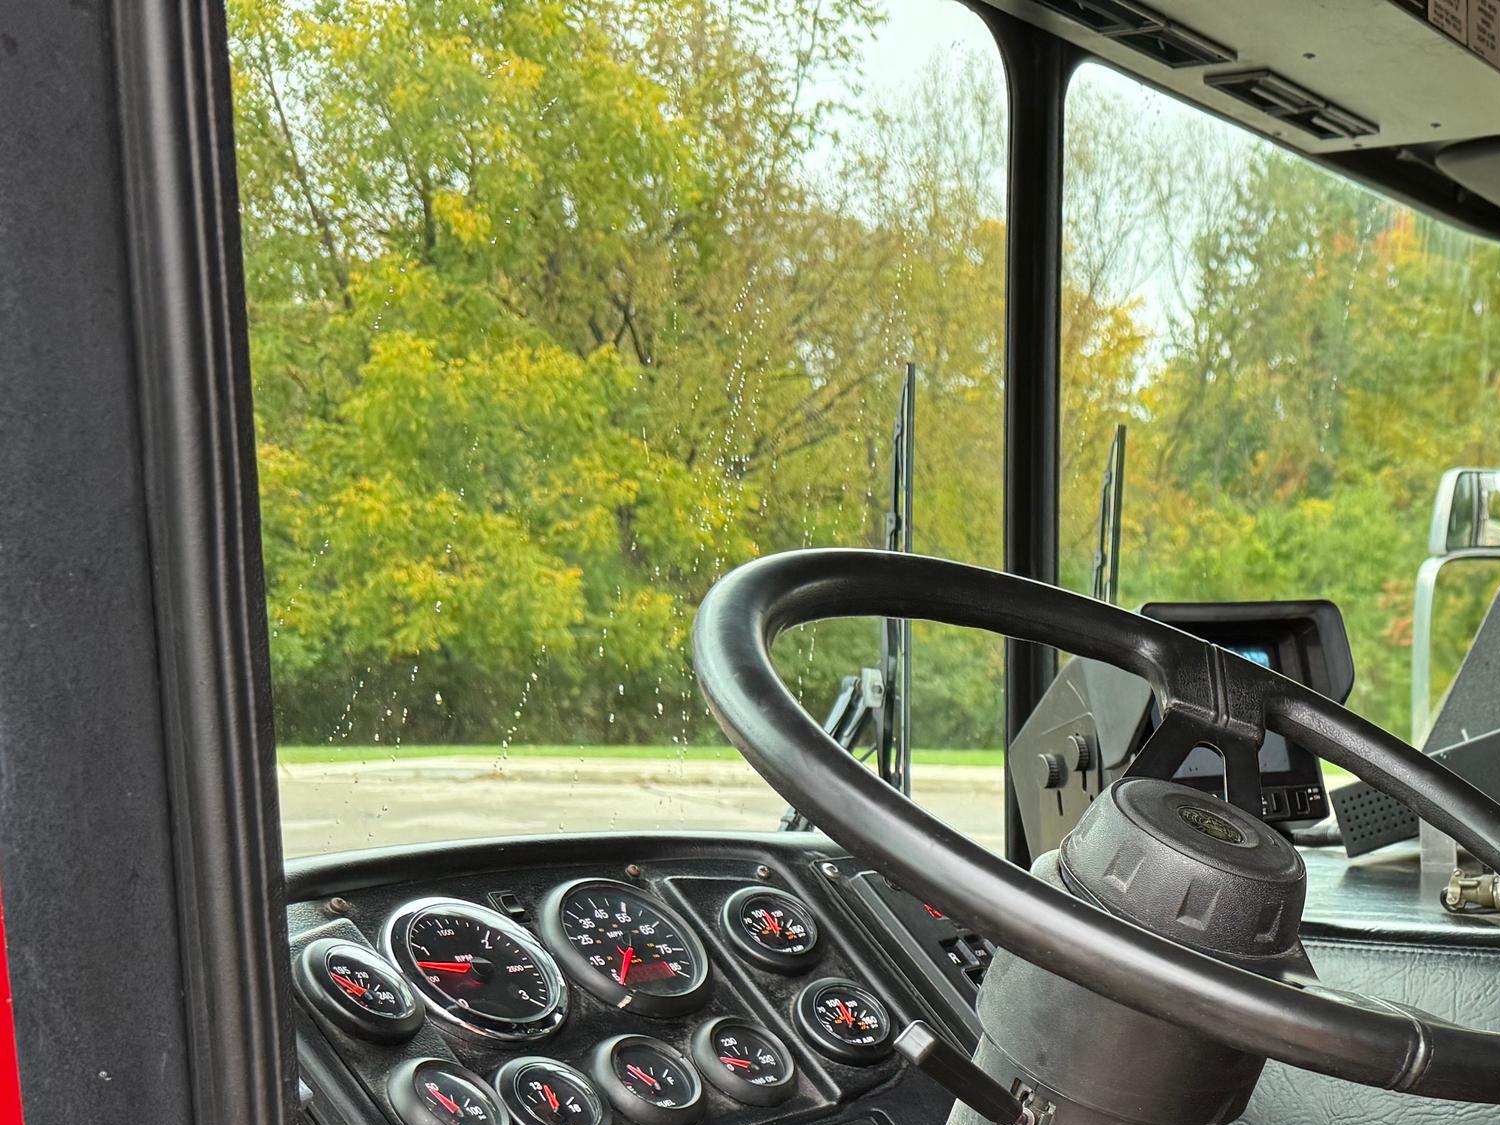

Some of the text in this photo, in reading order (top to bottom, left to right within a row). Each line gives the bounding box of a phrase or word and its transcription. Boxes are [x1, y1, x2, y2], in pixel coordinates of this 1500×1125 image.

[594, 909, 609, 920] 45
[615, 912, 632, 923] 55
[579, 918, 596, 929] 35
[437, 928, 455, 937] 1500
[606, 930, 624, 939] MPH
[639, 924, 655, 935] 65
[481, 938, 493, 950] 2
[577, 934, 594, 945] 25
[420, 946, 431, 956] 1
[655, 943, 672, 955] 75
[454, 953, 474, 963] RPM
[947, 952, 962, 964] R
[332, 966, 351, 975] 195
[506, 965, 524, 973] 2500
[669, 962, 682, 972] 85
[518, 989, 530, 1001] 3
[666, 1076, 675, 1085] F
[529, 1081, 542, 1091] 13
[466, 1106, 484, 1115] 100
